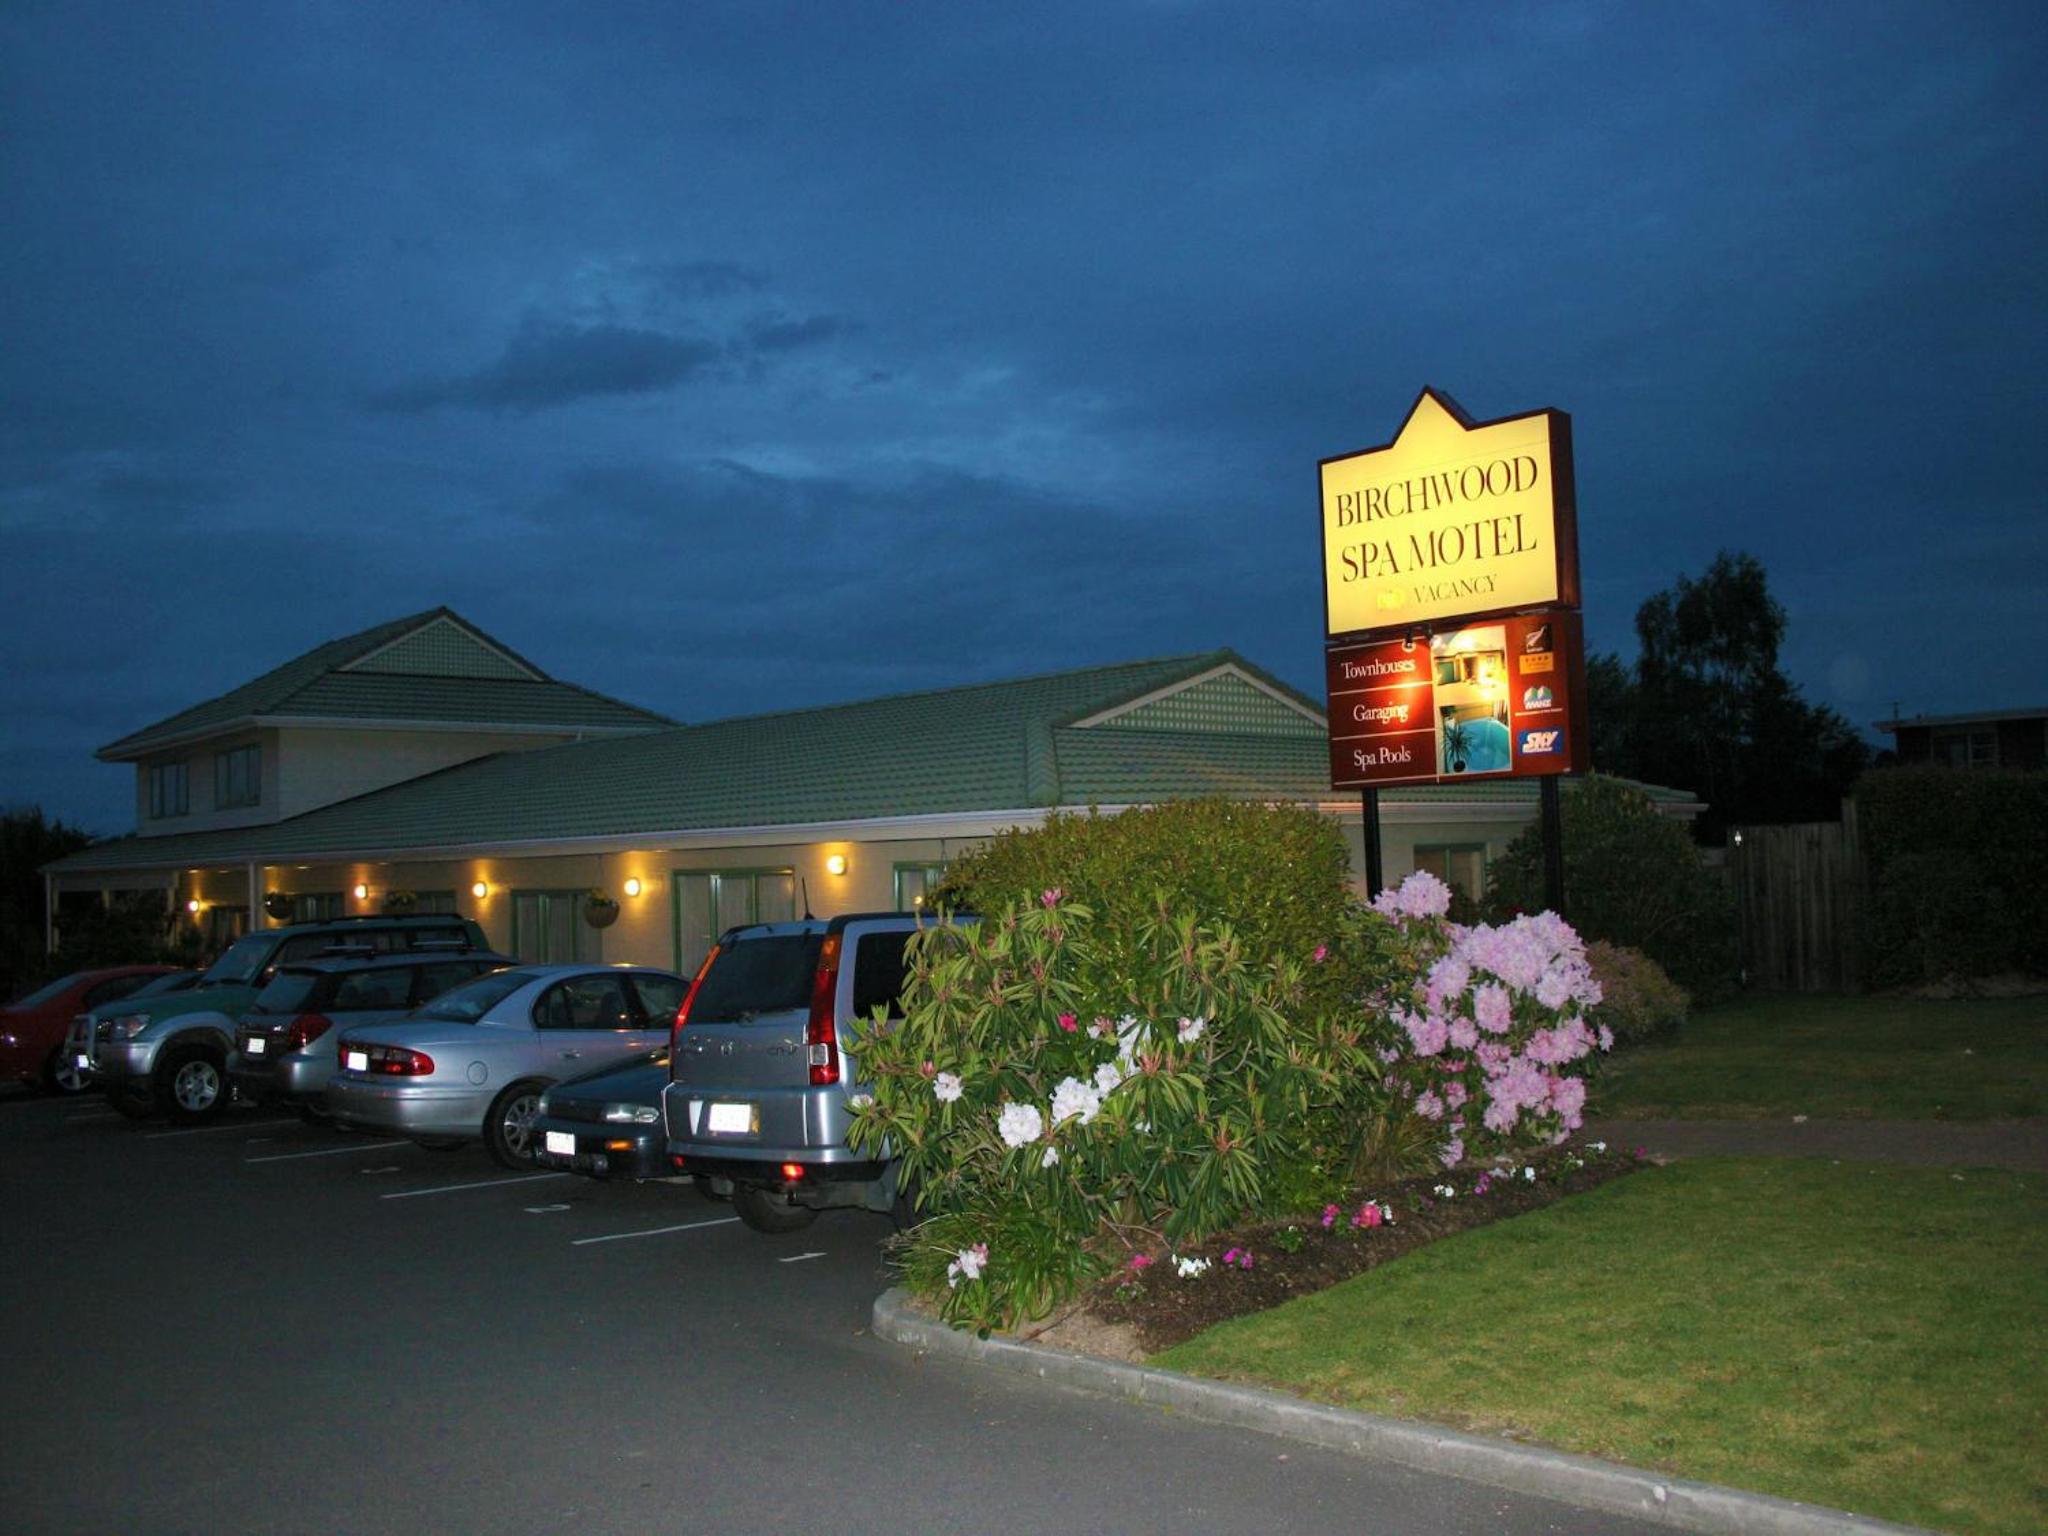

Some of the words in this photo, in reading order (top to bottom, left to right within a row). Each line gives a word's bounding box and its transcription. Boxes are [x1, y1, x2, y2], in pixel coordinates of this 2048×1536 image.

[1336, 455, 1538, 528] BIRCHWOOD
[1341, 539, 1400, 583] SPA
[1409, 513, 1537, 572] MOTEL
[1413, 574, 1497, 604] VACANCY
[1341, 658, 1416, 679] Townhouses
[1353, 701, 1409, 725] Garaging
[1524, 731, 1559, 748] SKY
[1353, 749, 1377, 772] Spa
[1379, 745, 1412, 765] Pools
